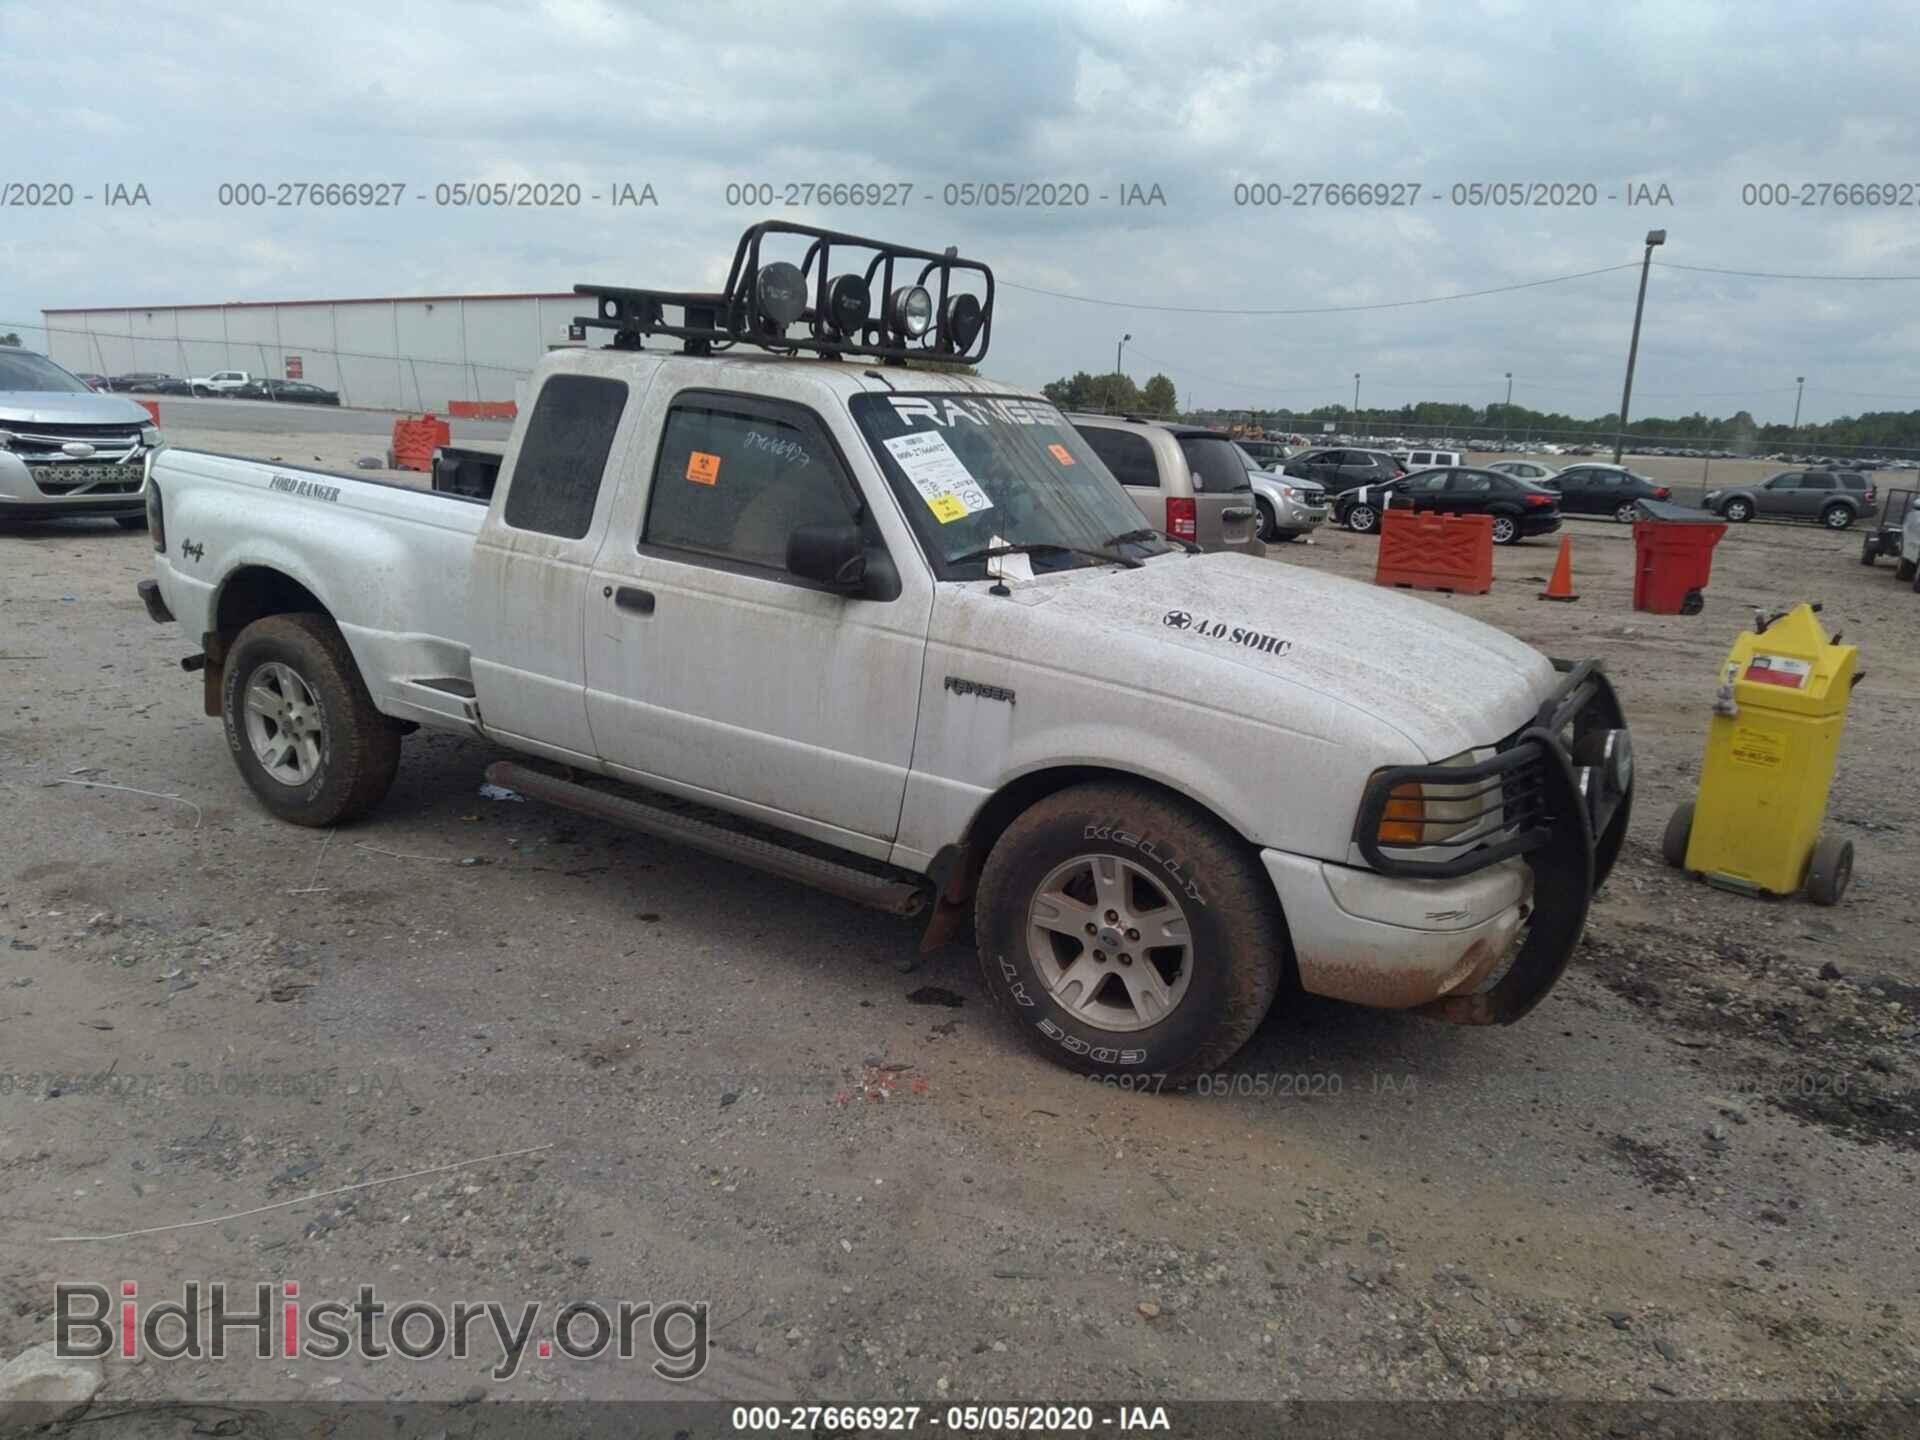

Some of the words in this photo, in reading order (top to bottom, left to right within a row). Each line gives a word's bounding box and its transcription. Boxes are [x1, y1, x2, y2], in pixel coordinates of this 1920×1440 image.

[269, 475, 298, 494] FORD
[296, 480, 341, 501] RANGER
[181, 538, 205, 563] 4x4
[1193, 619, 1228, 640] 4.0
[1229, 628, 1292, 657] SOHC
[944, 676, 1016, 704] RANGER
[1083, 825, 1207, 907] KELLY
[1036, 1018, 1148, 1065] EDGE
